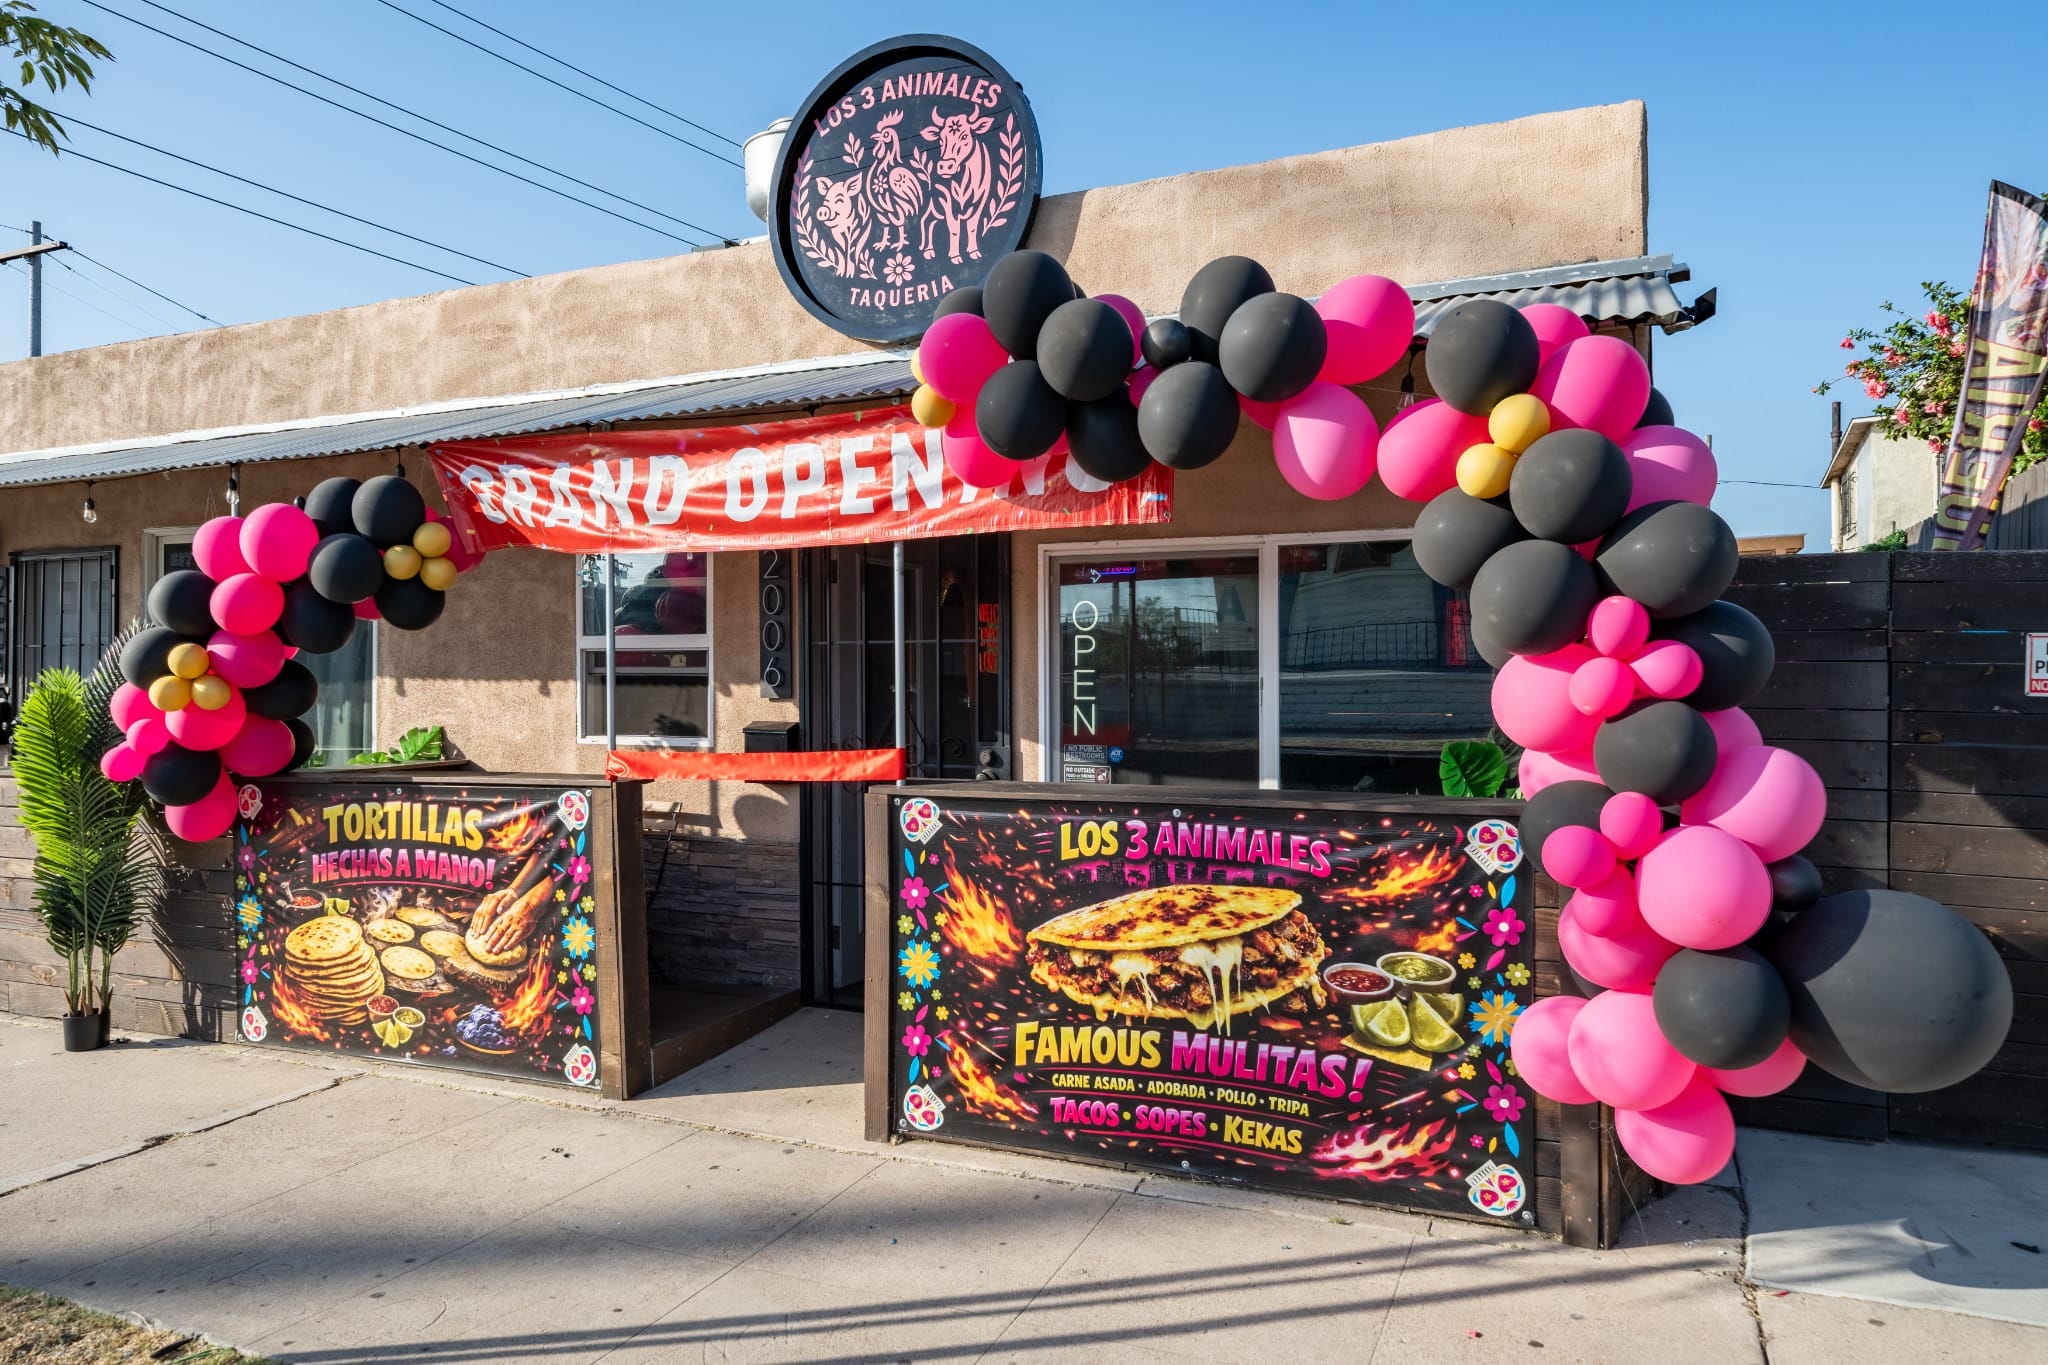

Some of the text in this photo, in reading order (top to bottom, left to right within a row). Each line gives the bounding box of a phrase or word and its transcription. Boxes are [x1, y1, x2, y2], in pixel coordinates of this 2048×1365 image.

[814, 72, 1002, 137] LOS 3 ANIMALES
[850, 275, 954, 310] TAQUERIA
[459, 429, 1113, 533] GRAND OPEN
[762, 549, 781, 687] 2006
[1072, 600, 1098, 737] OPEN
[1066, 751, 1105, 759] RESTROOMS
[322, 801, 486, 851] TORTILLAS
[1060, 820, 1331, 878] LOS 3 ANIMALES
[312, 848, 496, 890] HECHAS A MANO!
[1015, 1020, 1374, 1103] FAMOUS MULITAS!
[1052, 1073, 1310, 1117] CARNE ASADA ADOBADA POLLO TRIPA
[1050, 1096, 1303, 1154] TACOS SOPES KEKAS
